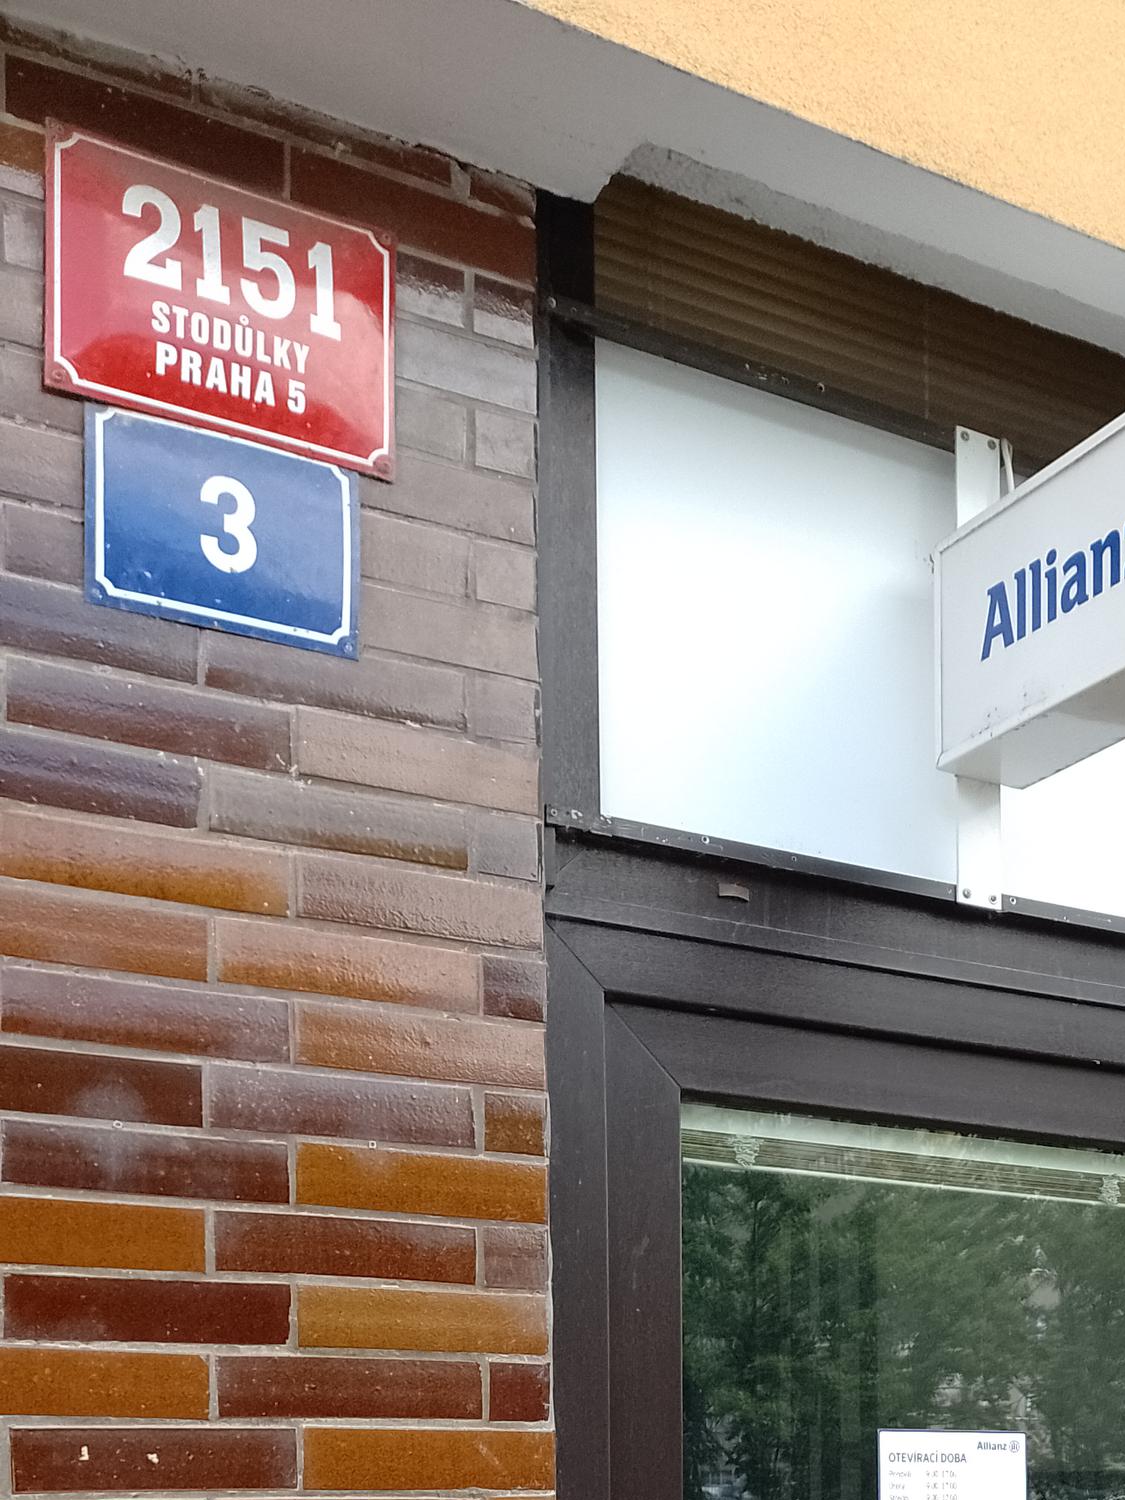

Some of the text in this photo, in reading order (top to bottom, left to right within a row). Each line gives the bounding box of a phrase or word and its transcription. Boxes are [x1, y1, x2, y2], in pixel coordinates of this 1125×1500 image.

[121, 183, 342, 341] 2151
[151, 299, 310, 375] STODŮLKY
[155, 341, 306, 414] PRAHA 5
[199, 475, 258, 574] 3
[888, 1450, 967, 1463] OTEVÍRACÍ DOBA
[976, 1441, 1008, 1451] Allianz
